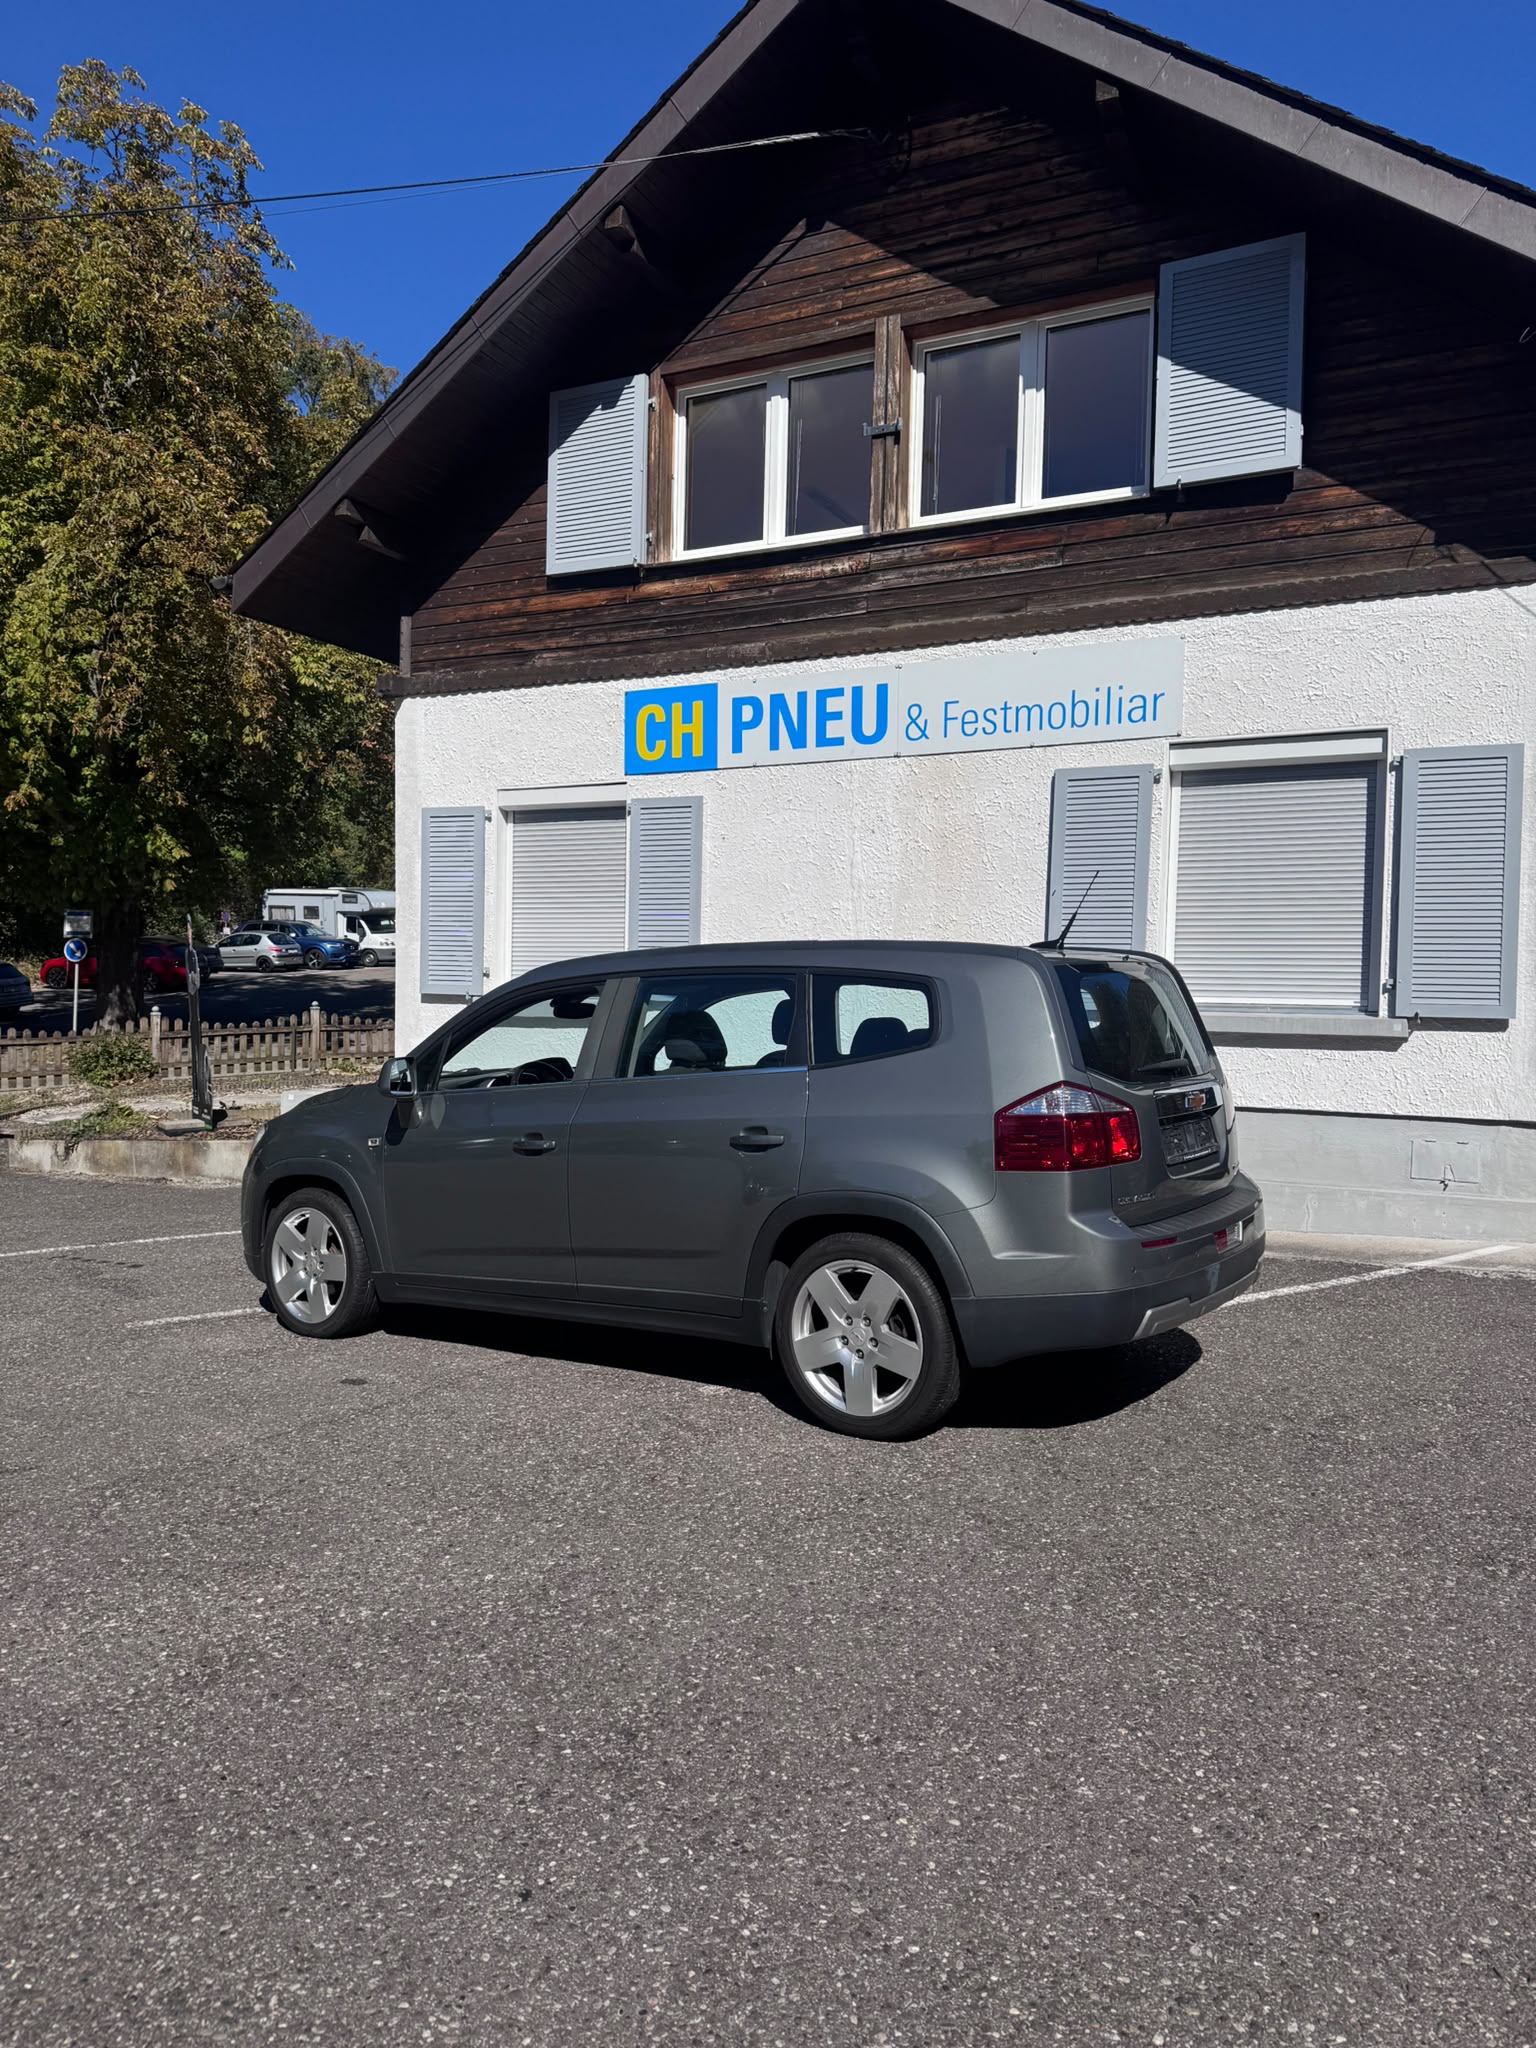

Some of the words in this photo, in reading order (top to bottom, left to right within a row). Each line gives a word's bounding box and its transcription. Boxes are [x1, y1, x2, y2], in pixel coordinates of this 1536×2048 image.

[635, 700, 703, 761] CH
[731, 682, 889, 756] PNEU
[904, 703, 930, 743] &
[943, 685, 1166, 739] Festmobiliar
